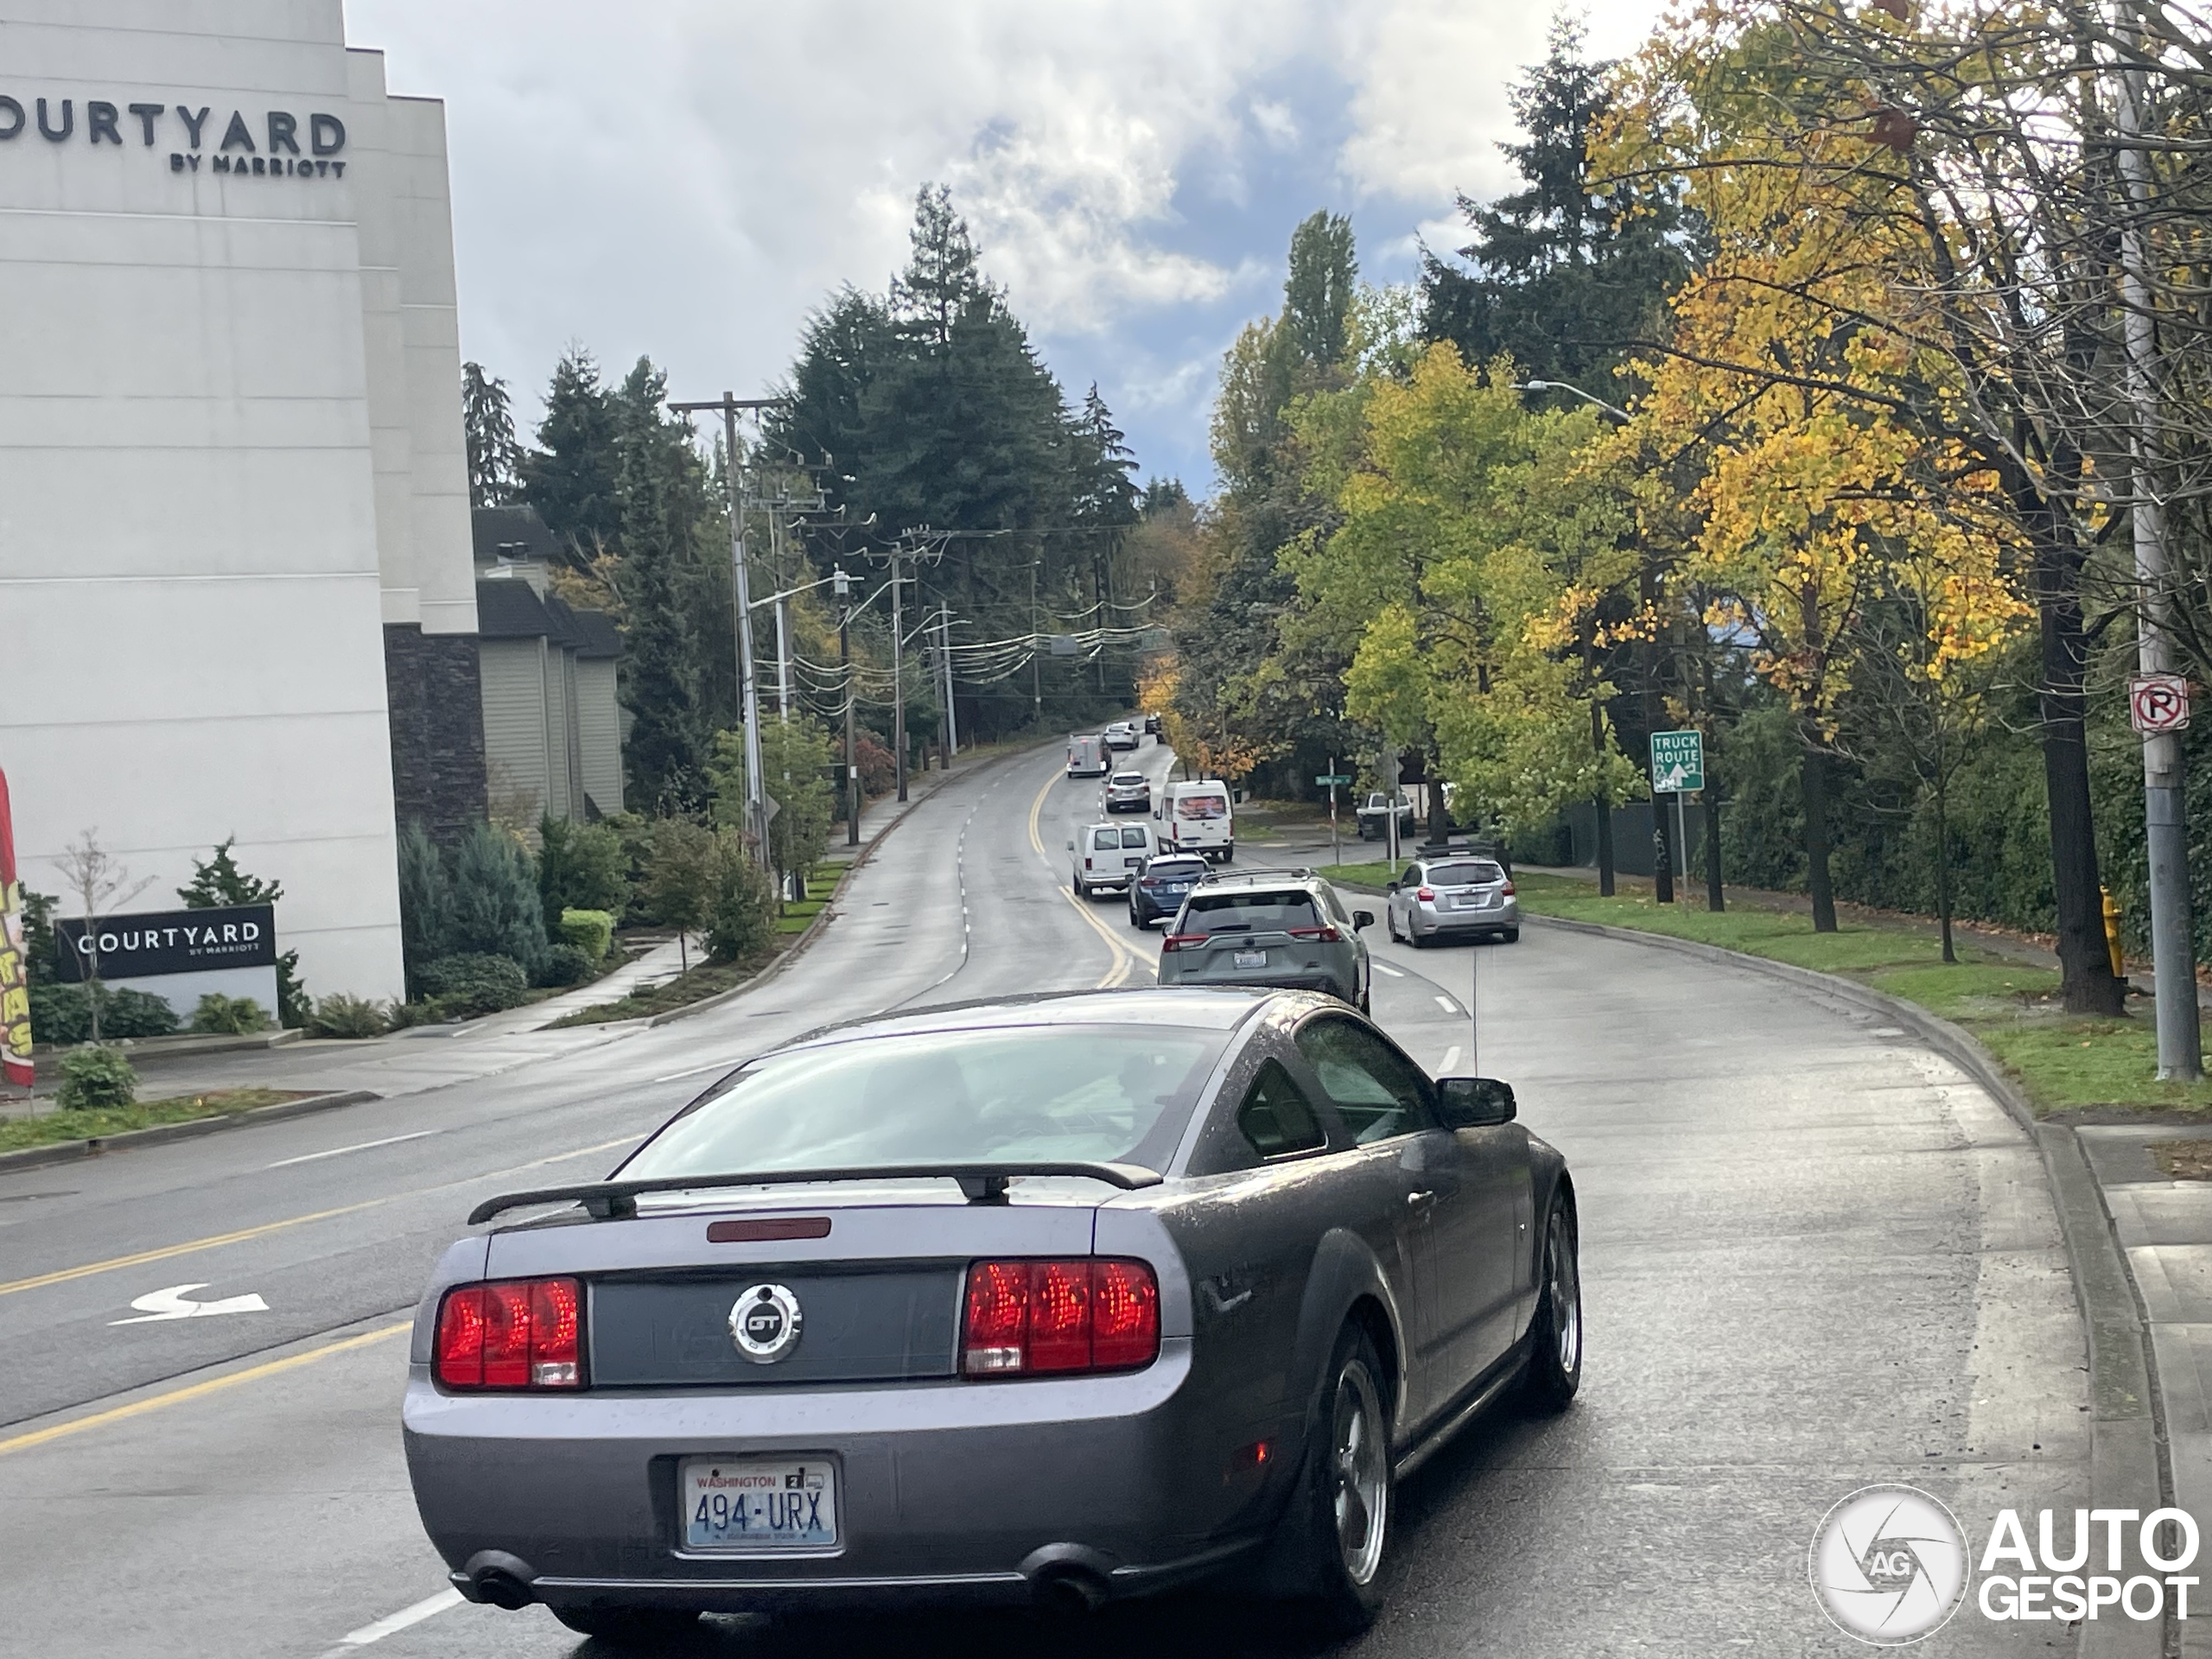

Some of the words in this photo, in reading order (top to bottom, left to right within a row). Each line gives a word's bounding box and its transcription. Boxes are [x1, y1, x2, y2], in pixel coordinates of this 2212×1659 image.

[0, 94, 346, 155] OURTYARD
[170, 153, 201, 173] BY
[213, 155, 346, 179] MARRIOTT
[1655, 735, 1698, 750] TRUCK
[1656, 749, 1699, 764] ROUTE
[78, 922, 259, 954] COURTYARD
[206, 943, 259, 955] MARRIOTT
[747, 1315, 780, 1331] GT
[696, 1476, 776, 1488] WASHINGTON
